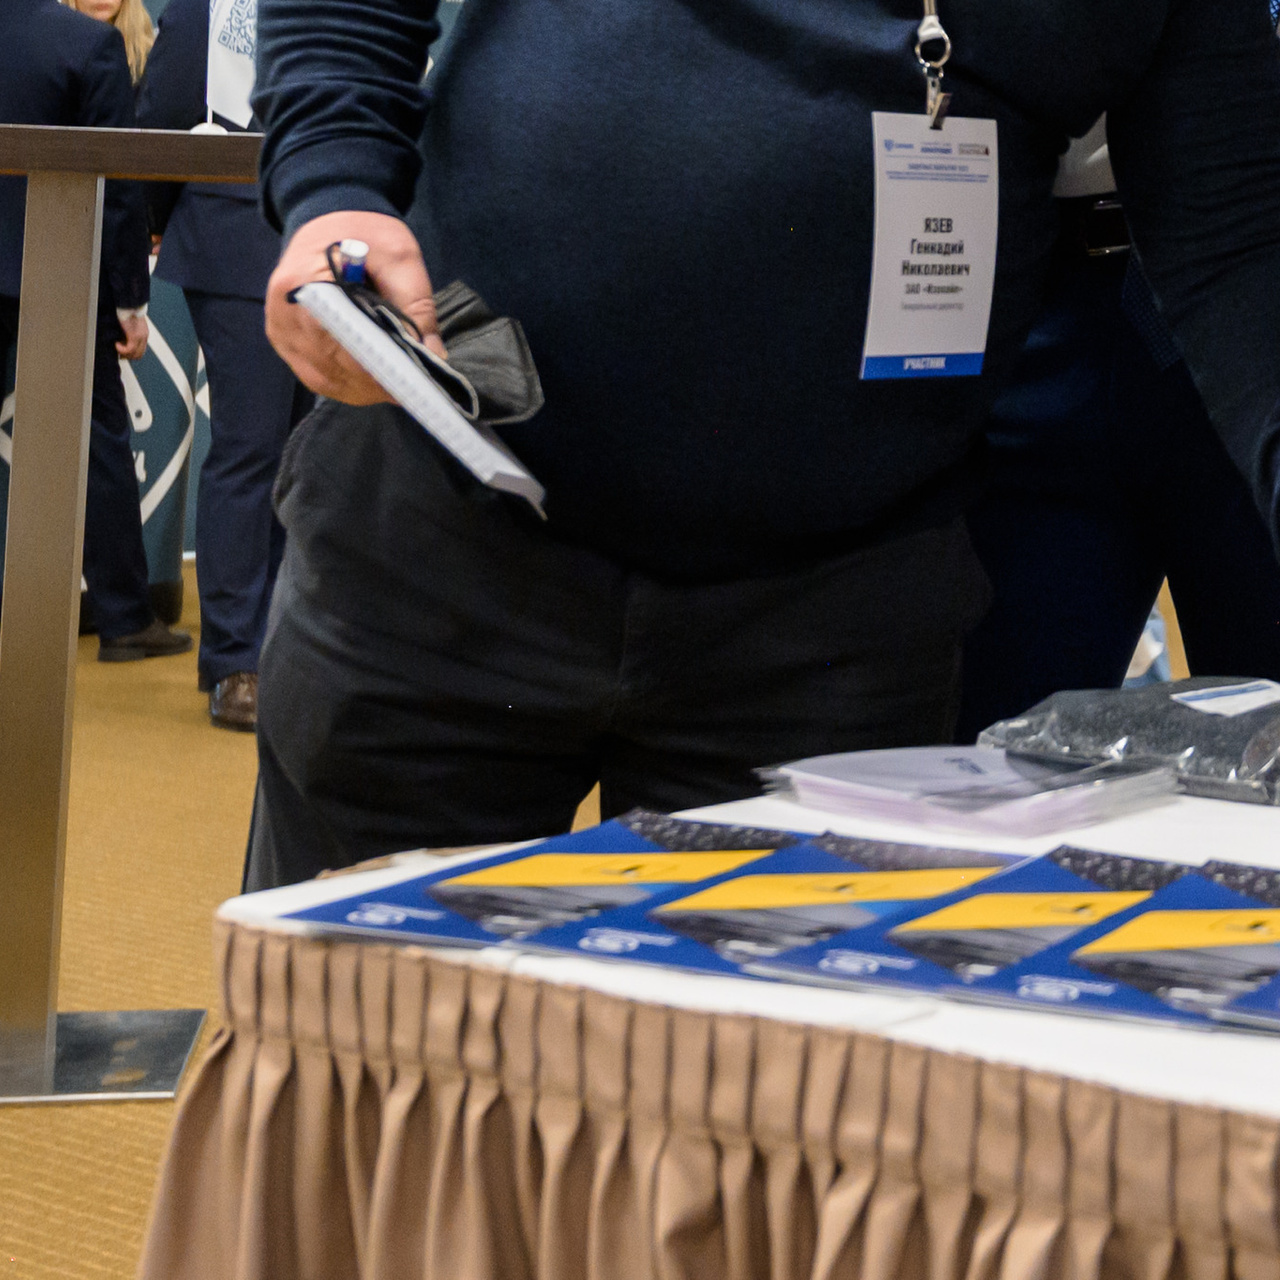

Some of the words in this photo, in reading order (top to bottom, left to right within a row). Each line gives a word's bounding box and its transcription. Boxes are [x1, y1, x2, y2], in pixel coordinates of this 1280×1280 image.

[924, 218, 953, 233] ЯЗЕВ
[910, 237, 955, 255] Геннадий
[902, 260, 970, 276] Николаевич
